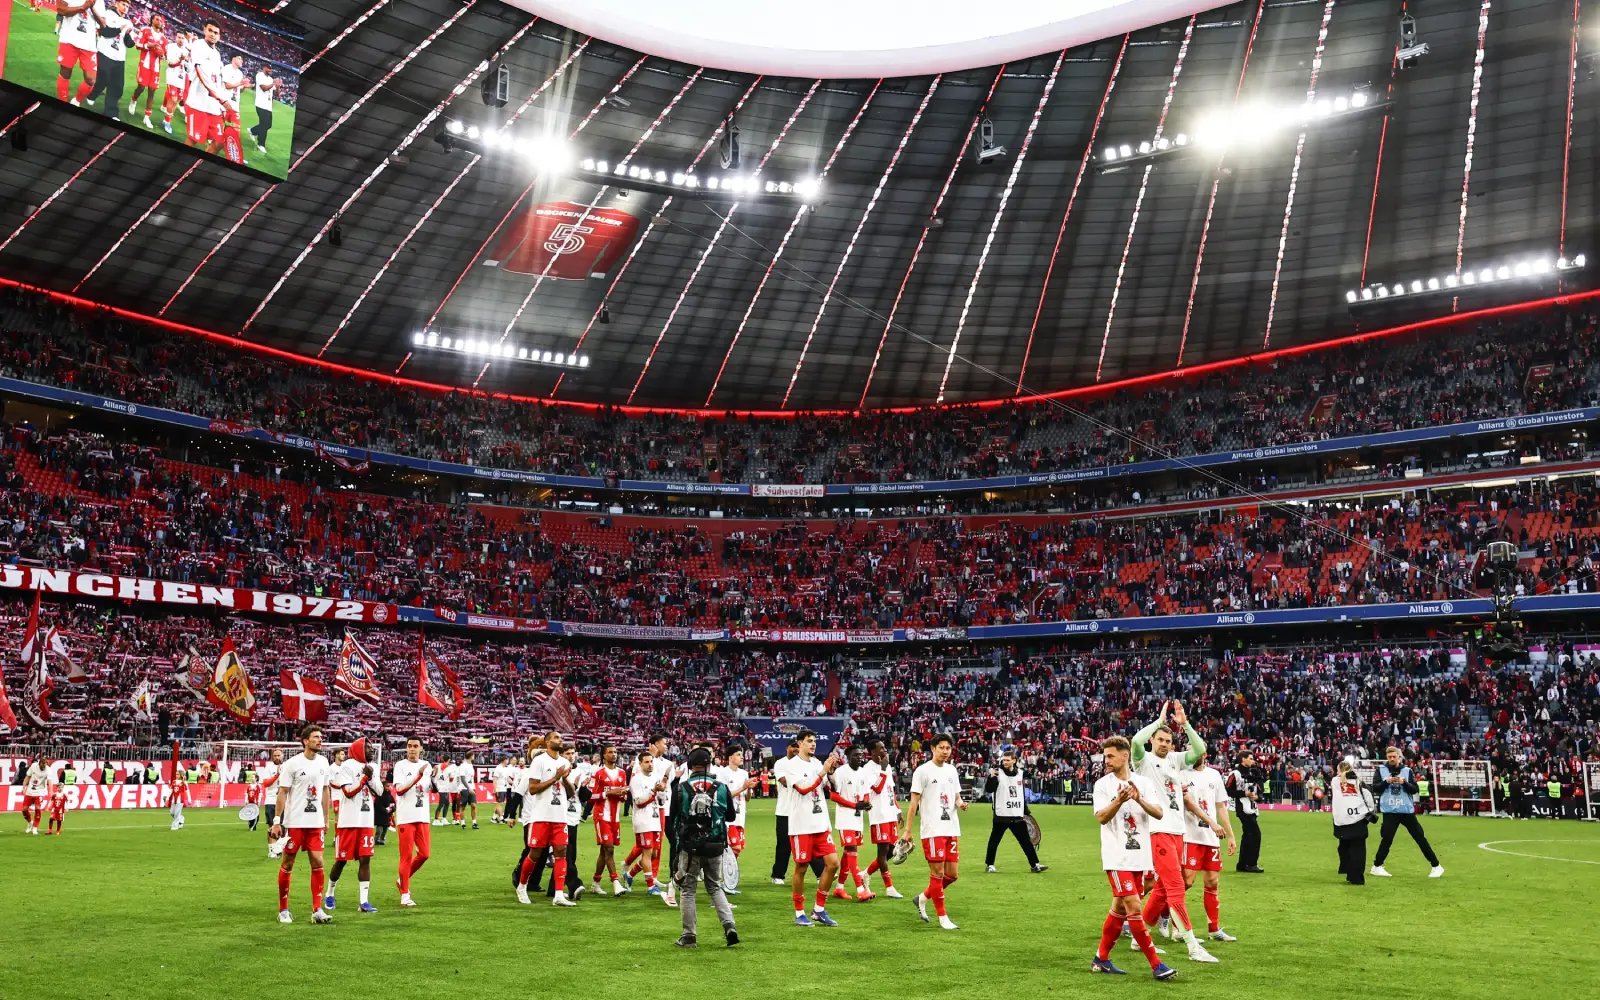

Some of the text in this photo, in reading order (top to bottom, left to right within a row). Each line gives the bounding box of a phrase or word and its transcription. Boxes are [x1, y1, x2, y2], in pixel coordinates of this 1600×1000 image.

[543, 222, 594, 255] 5
[103, 400, 126, 412] Allianz
[1478, 412, 1584, 430] Allianz Global Investors
[1264, 448, 1286, 456] Global
[1286, 444, 1318, 453] Investors
[474, 468, 492, 476] Allianz
[1058, 472, 1076, 480] Global
[1077, 470, 1103, 478] Investors
[251, 590, 365, 621] 1972
[1409, 604, 1440, 614] Allianz
[1216, 615, 1243, 623] Allianz
[782, 631, 845, 641] SCHLOSSPANTHER
[1347, 807, 1360, 816] 01
